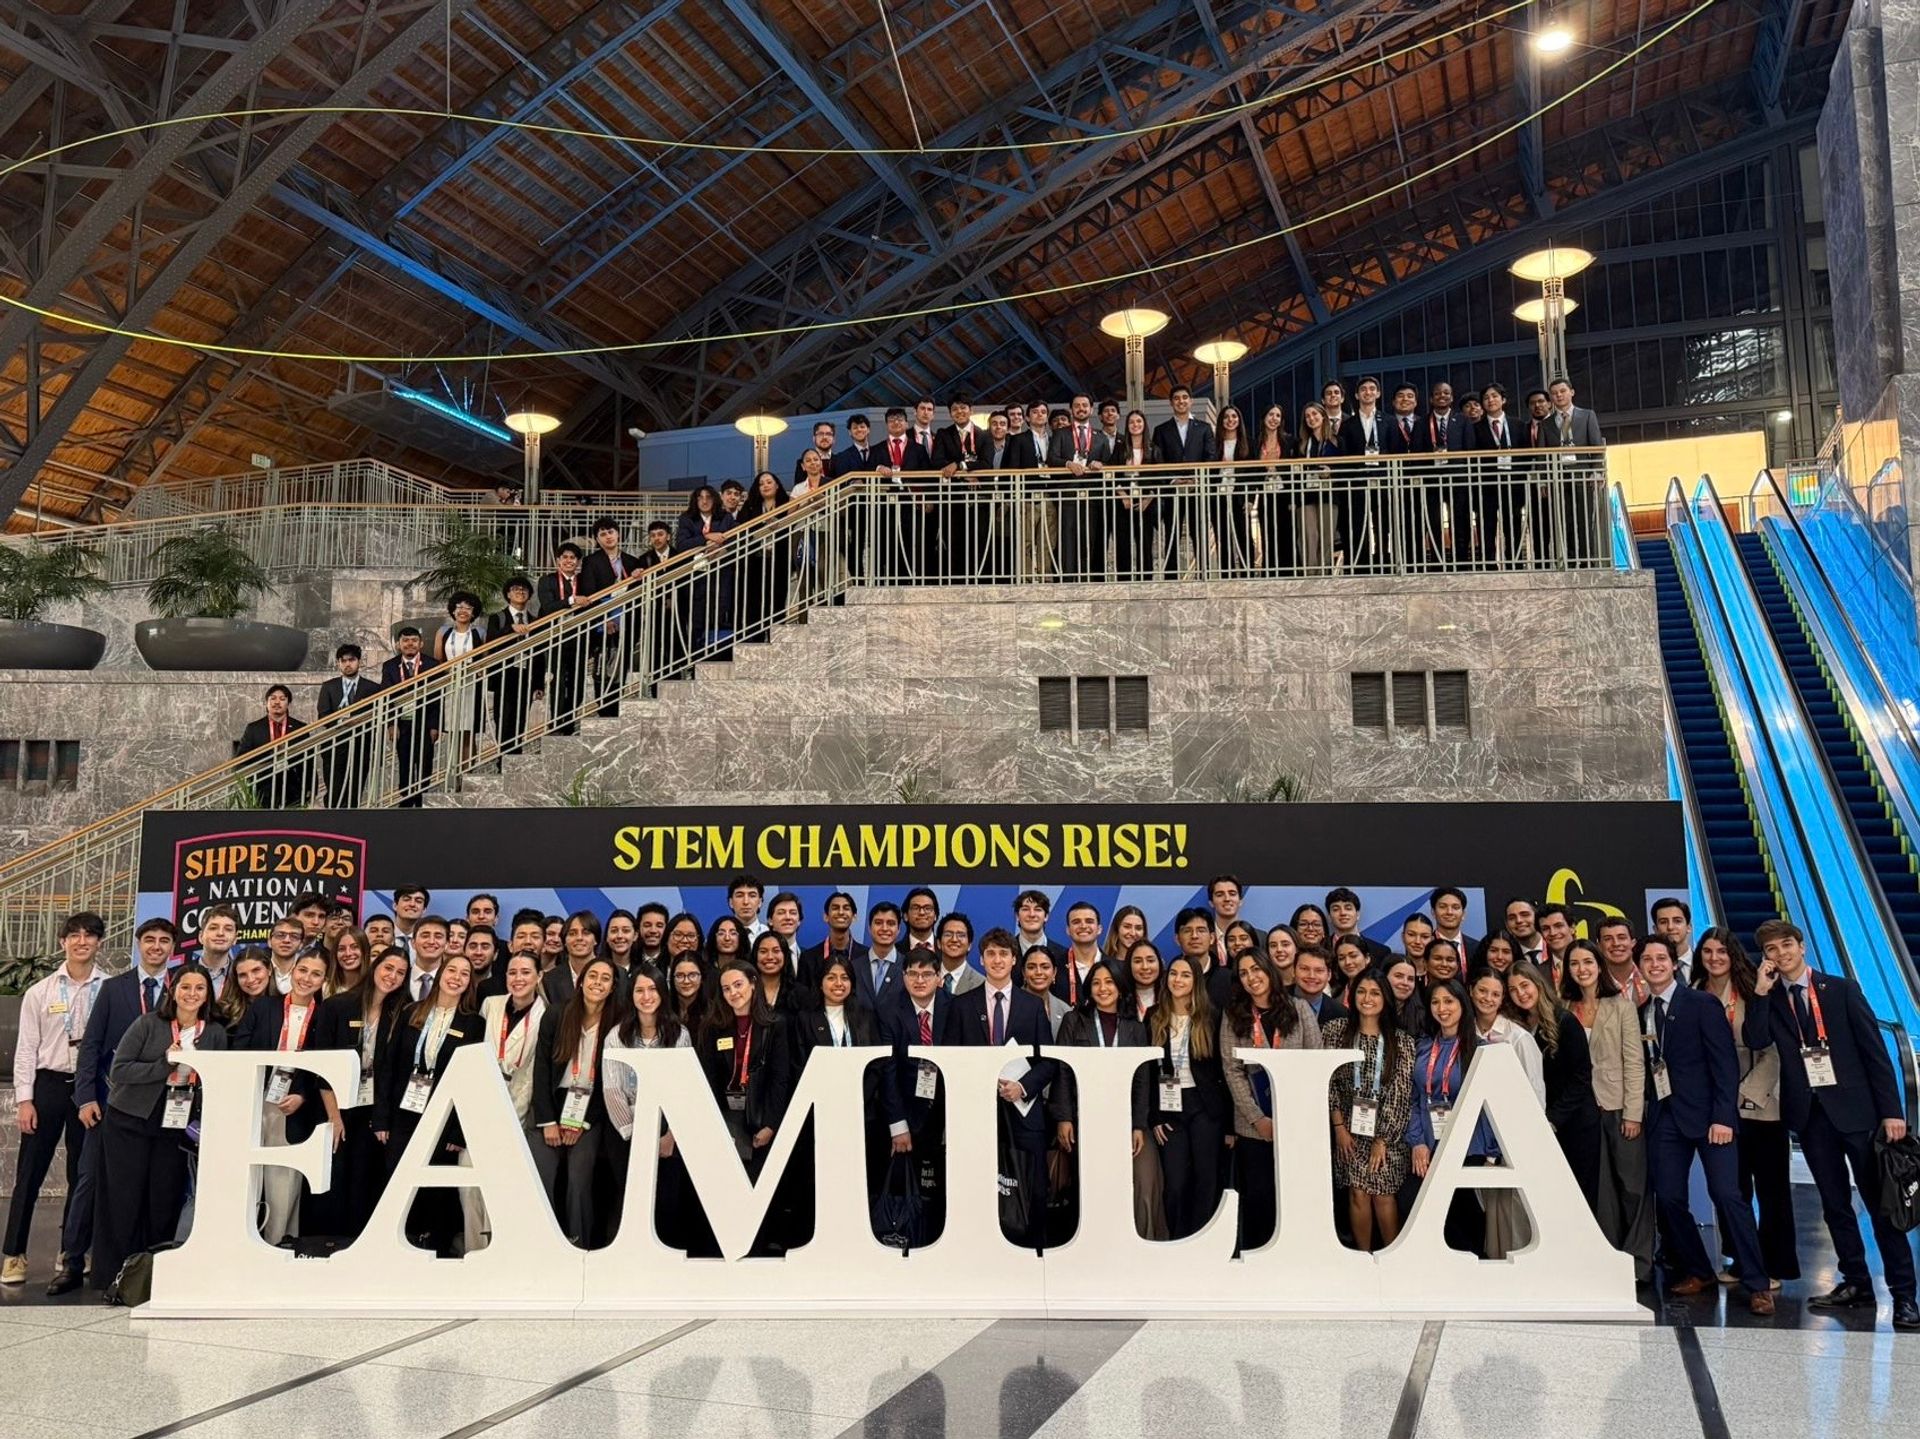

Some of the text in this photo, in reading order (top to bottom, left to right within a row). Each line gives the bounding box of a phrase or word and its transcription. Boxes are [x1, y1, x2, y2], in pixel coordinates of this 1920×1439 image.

[184, 843, 355, 881] SHPE 2025
[613, 823, 1188, 871] STEM CHAMPIONS RISE!
[151, 1041, 1636, 1267] FAMILIA
